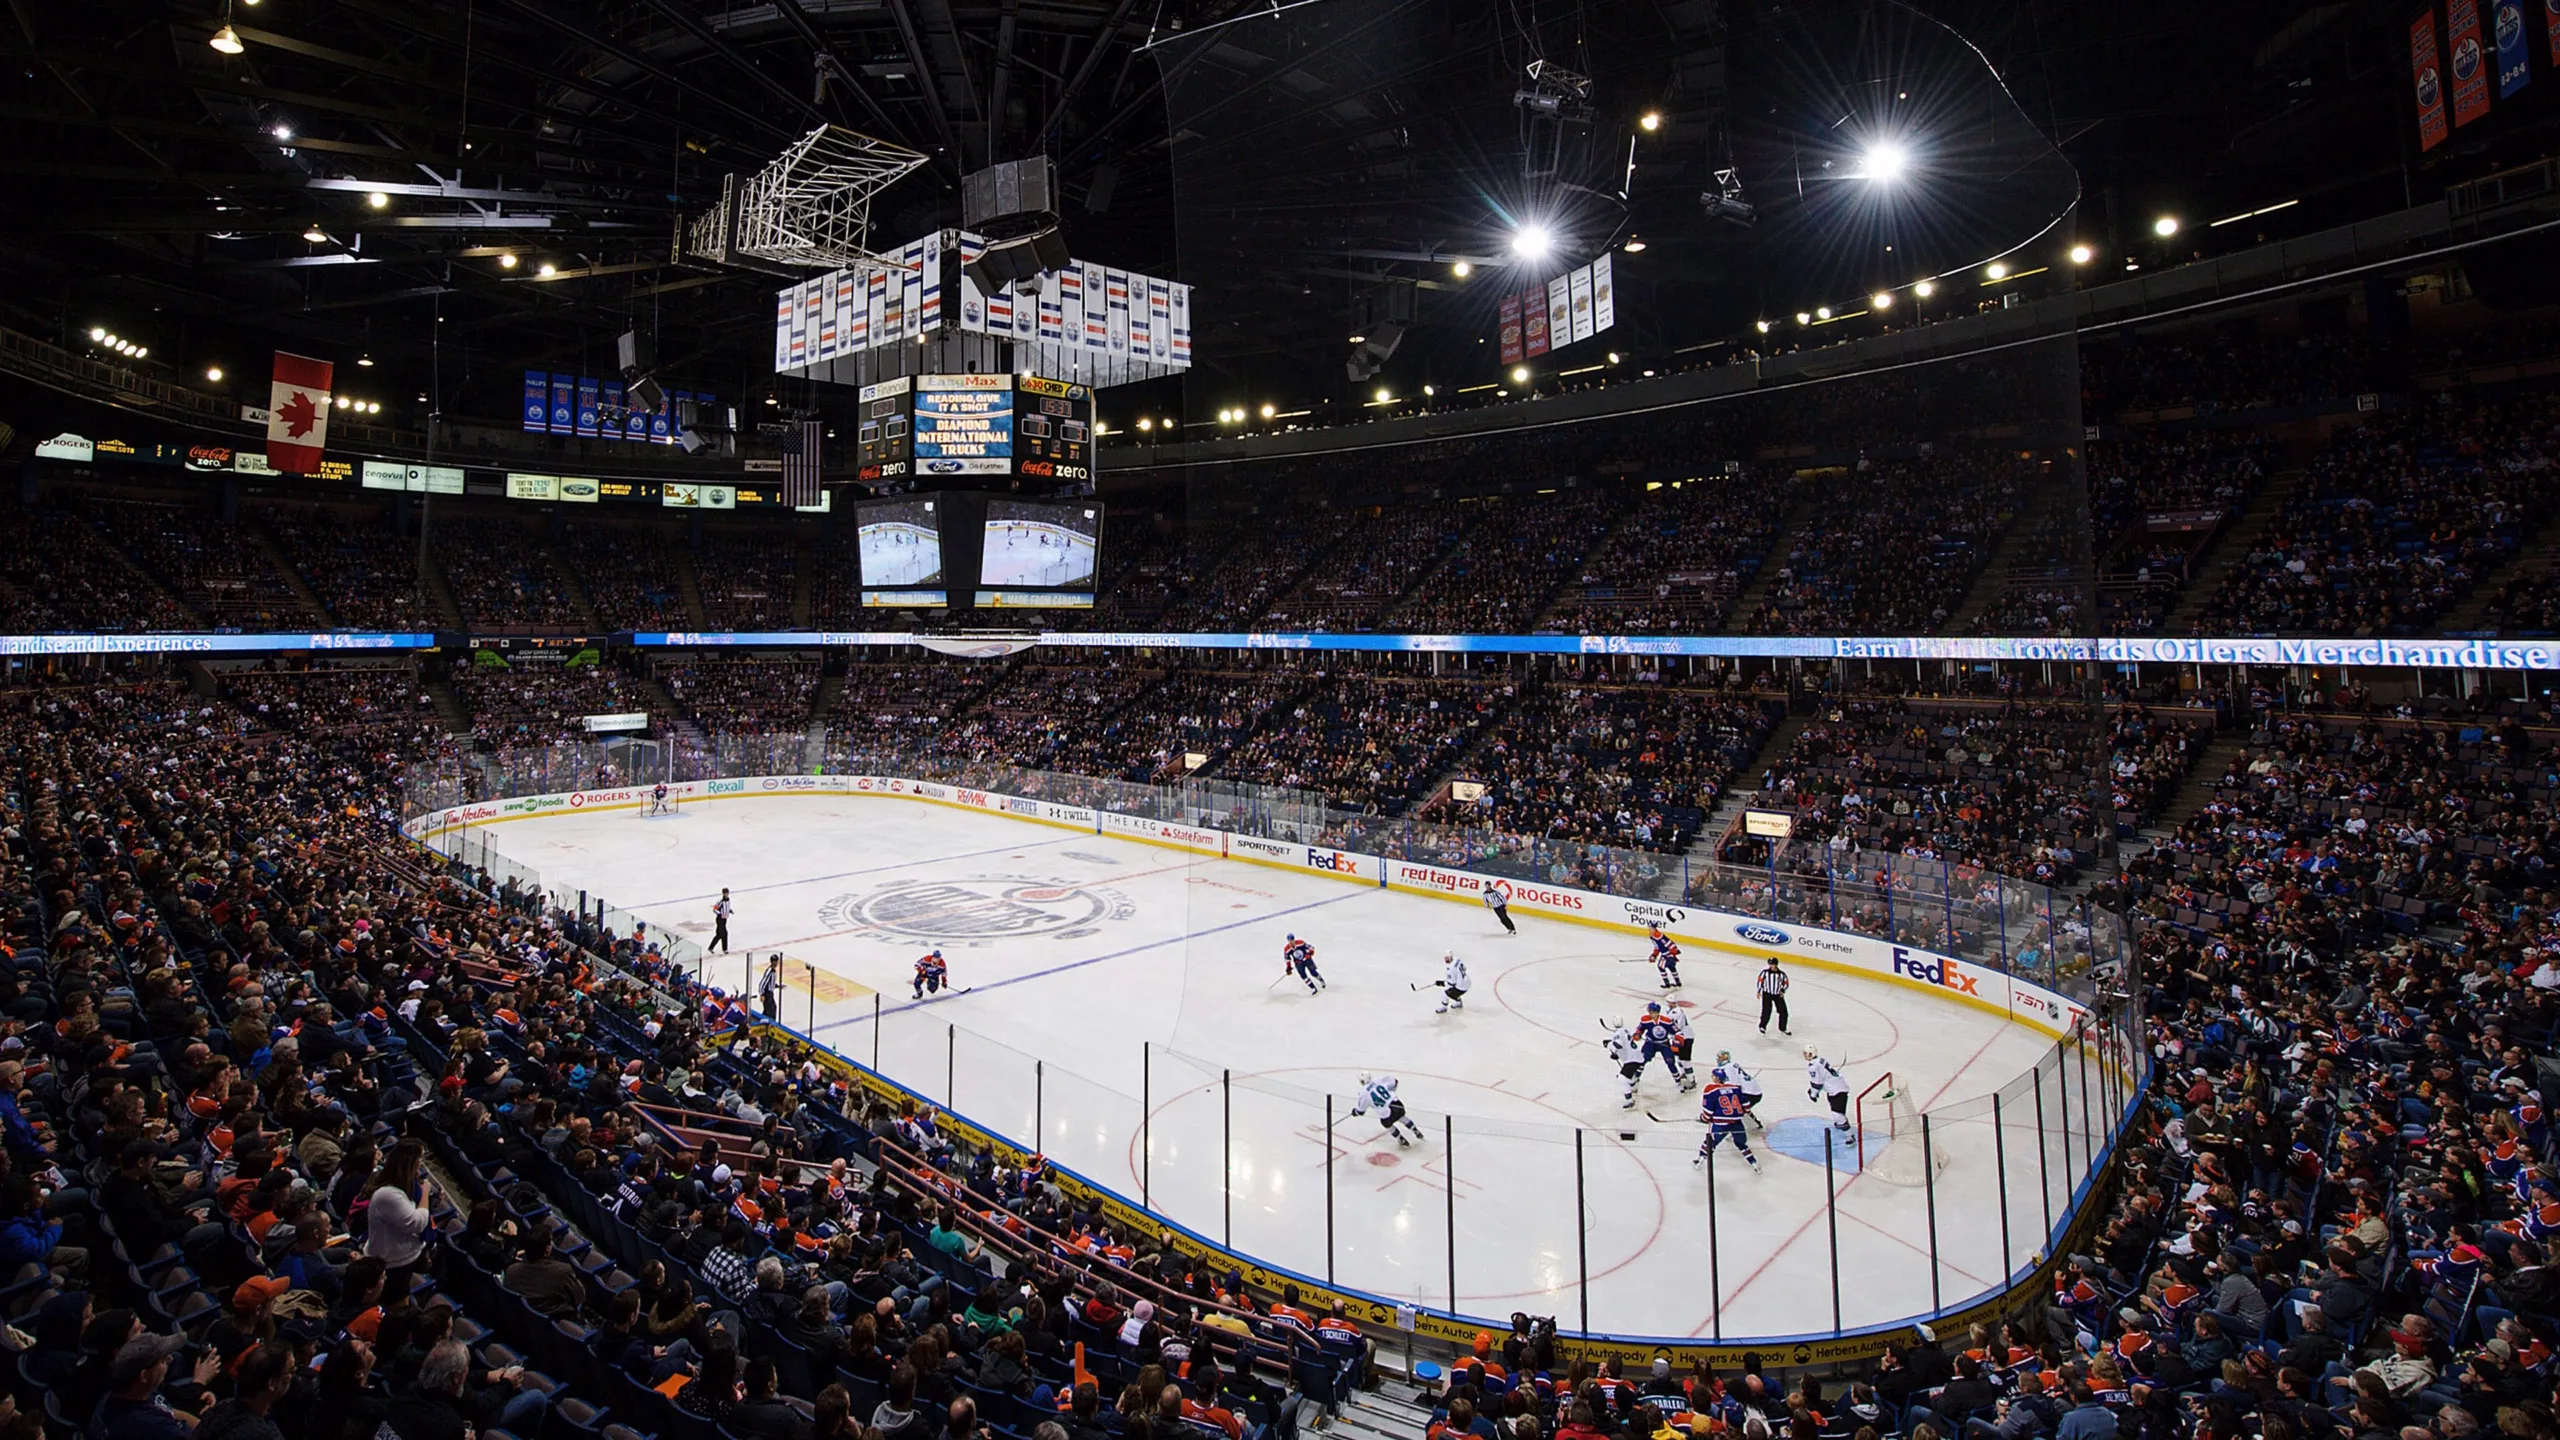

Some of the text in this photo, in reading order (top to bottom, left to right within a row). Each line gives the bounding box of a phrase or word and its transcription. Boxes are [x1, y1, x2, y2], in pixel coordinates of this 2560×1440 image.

[863, 378, 907, 399] ATB Financial
[1026, 379, 1063, 393] 630 CHED
[558, 389, 567, 404] 9
[581, 393, 595, 408] 11
[938, 403, 989, 411] IT A SHOT
[937, 420, 990, 430] DIAMOND
[53, 440, 91, 449] ROGERS
[917, 432, 1008, 443] INTERNATIONAL
[97, 445, 135, 454] MINNESOTA
[940, 444, 986, 455] TRUCKS
[197, 458, 220, 467] zero
[882, 462, 906, 476] zero
[1056, 464, 1087, 479] zero
[62, 635, 97, 652] and
[102, 635, 211, 652] Experiences
[822, 632, 854, 644] Earn
[1086, 633, 1180, 646] and Experiences
[1834, 638, 1899, 657] Earn
[2013, 639, 2145, 661] towards
[2153, 638, 2266, 662] Oilers
[2277, 639, 2548, 669] Merchandise
[708, 779, 744, 793] Rexall
[504, 802, 523, 811] save
[538, 797, 564, 807] foods
[587, 791, 631, 803] ROGERS
[958, 789, 987, 807] RE/MAX
[444, 807, 497, 825] Tim Hortons
[1108, 814, 1156, 831] THE KEG
[1237, 840, 1291, 855] SPORTSNET
[1308, 848, 1357, 874] FedEx
[1401, 866, 1479, 890] red tag.ca
[1517, 888, 1583, 909] ROGERS
[1624, 902, 1664, 917] Capital
[855, 931, 994, 949] PLACE
[1744, 924, 1853, 954] Ford Go Further
[1893, 946, 1979, 996] FedEx
[2015, 991, 2045, 1011] TSN
[1718, 1094, 1743, 1115] 94
[1816, 1345, 1858, 1358] Herbers
